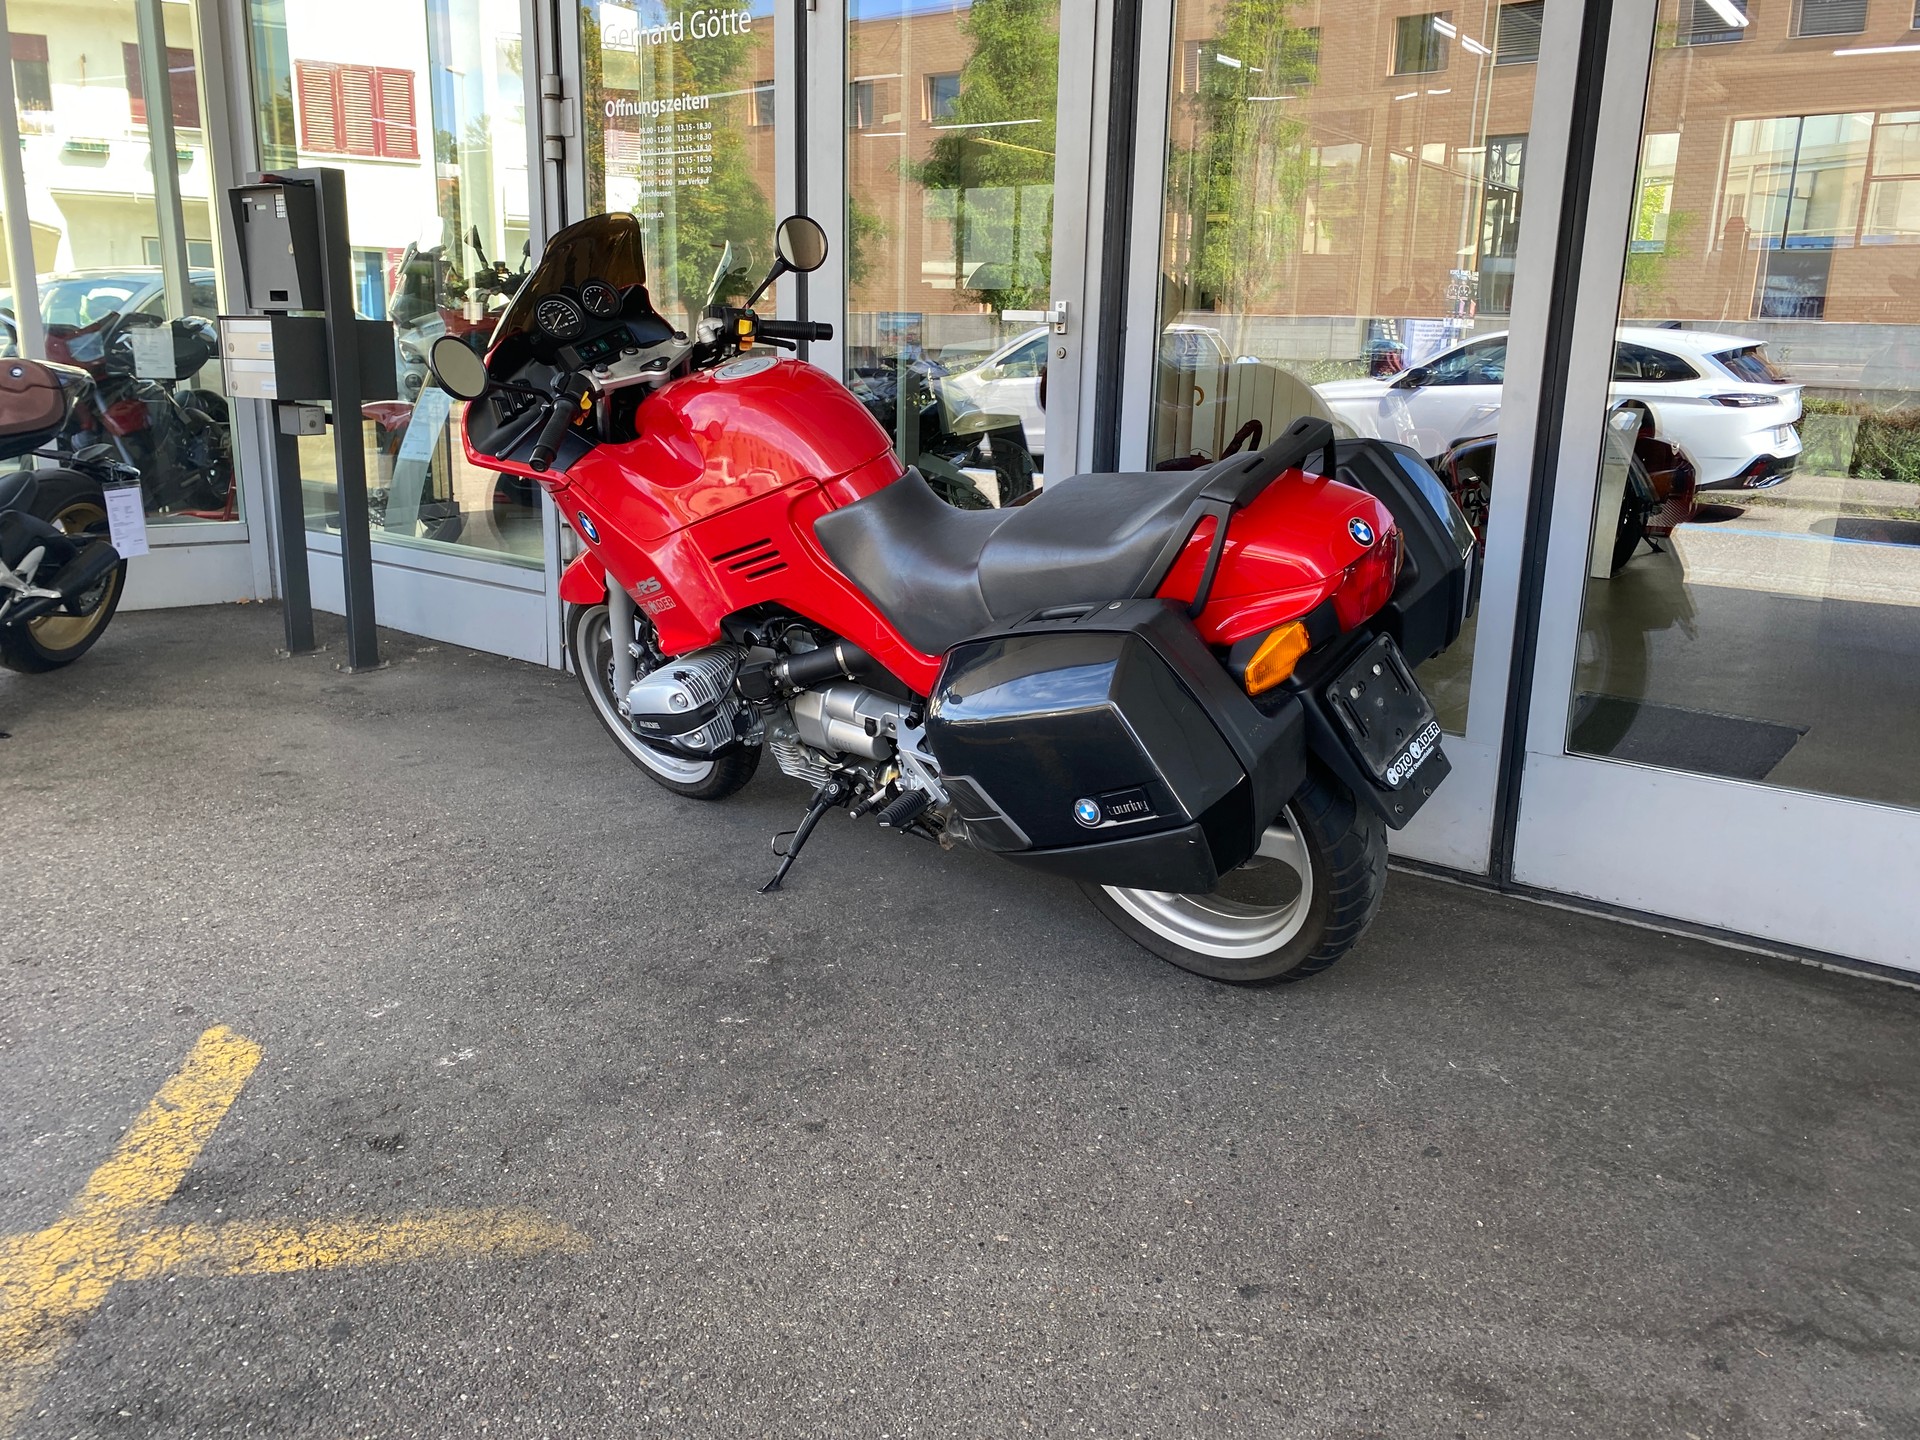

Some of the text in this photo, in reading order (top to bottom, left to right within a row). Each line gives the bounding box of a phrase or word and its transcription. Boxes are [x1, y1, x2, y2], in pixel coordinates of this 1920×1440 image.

[690, 8, 752, 39] Götte
[657, 125, 672, 133] 12.00
[677, 123, 692, 132] 13.15
[696, 122, 712, 130] 18.30
[657, 136, 672, 144] 12.00
[677, 134, 692, 143] 13.15
[696, 133, 712, 141] 18.30
[657, 157, 673, 165] 12.00
[678, 155, 693, 164] 13.15
[697, 154, 712, 163] 18.30
[657, 168, 673, 176] 12.00
[678, 166, 693, 175] 13.15
[697, 165, 712, 174] 18.30
[658, 179, 673, 187] 14.00
[687, 176, 710, 185] Verkauf
